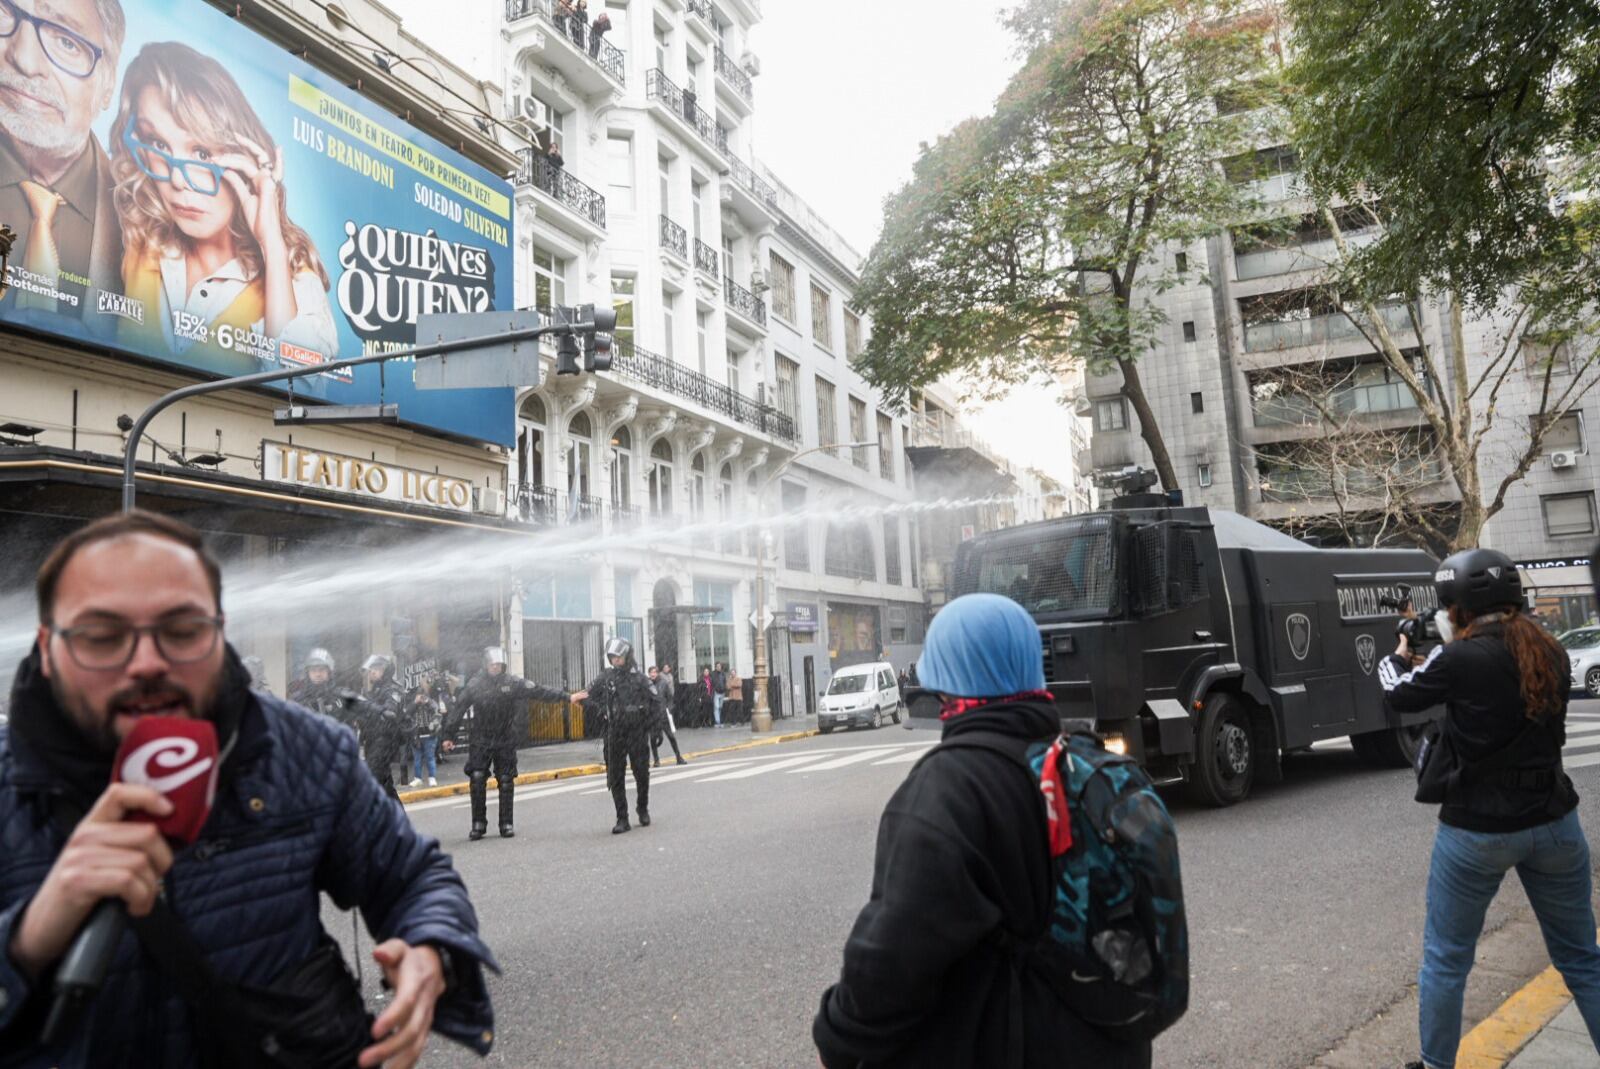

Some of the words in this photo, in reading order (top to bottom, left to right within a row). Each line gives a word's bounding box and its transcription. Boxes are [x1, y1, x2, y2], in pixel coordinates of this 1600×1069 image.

[293, 117, 324, 152] LUIS
[327, 134, 394, 190] BRANDONI
[319, 99, 362, 134] ¡JUNTOS
[365, 123, 377, 141] EN
[418, 155, 435, 174] POR
[437, 166, 472, 196] PRIMERA
[474, 185, 491, 205] VEZ!
[414, 181, 462, 224] SOLEDAD
[464, 208, 508, 247] SILVEYRA
[338, 220, 461, 276] ¿QUIÉN
[461, 249, 486, 276] es
[6, 275, 78, 306] Rottemberg
[15, 266, 54, 287] Tomás
[57, 268, 92, 288] Producen
[98, 296, 142, 321] CABALLE
[173, 310, 207, 336] 15%
[217, 324, 234, 348] 6
[234, 328, 275, 351] CUOTAS
[235, 342, 247, 353] SIN
[277, 446, 388, 494] TEATRO
[402, 471, 469, 507] LICEO
[1337, 587, 1377, 617] POLICIA
